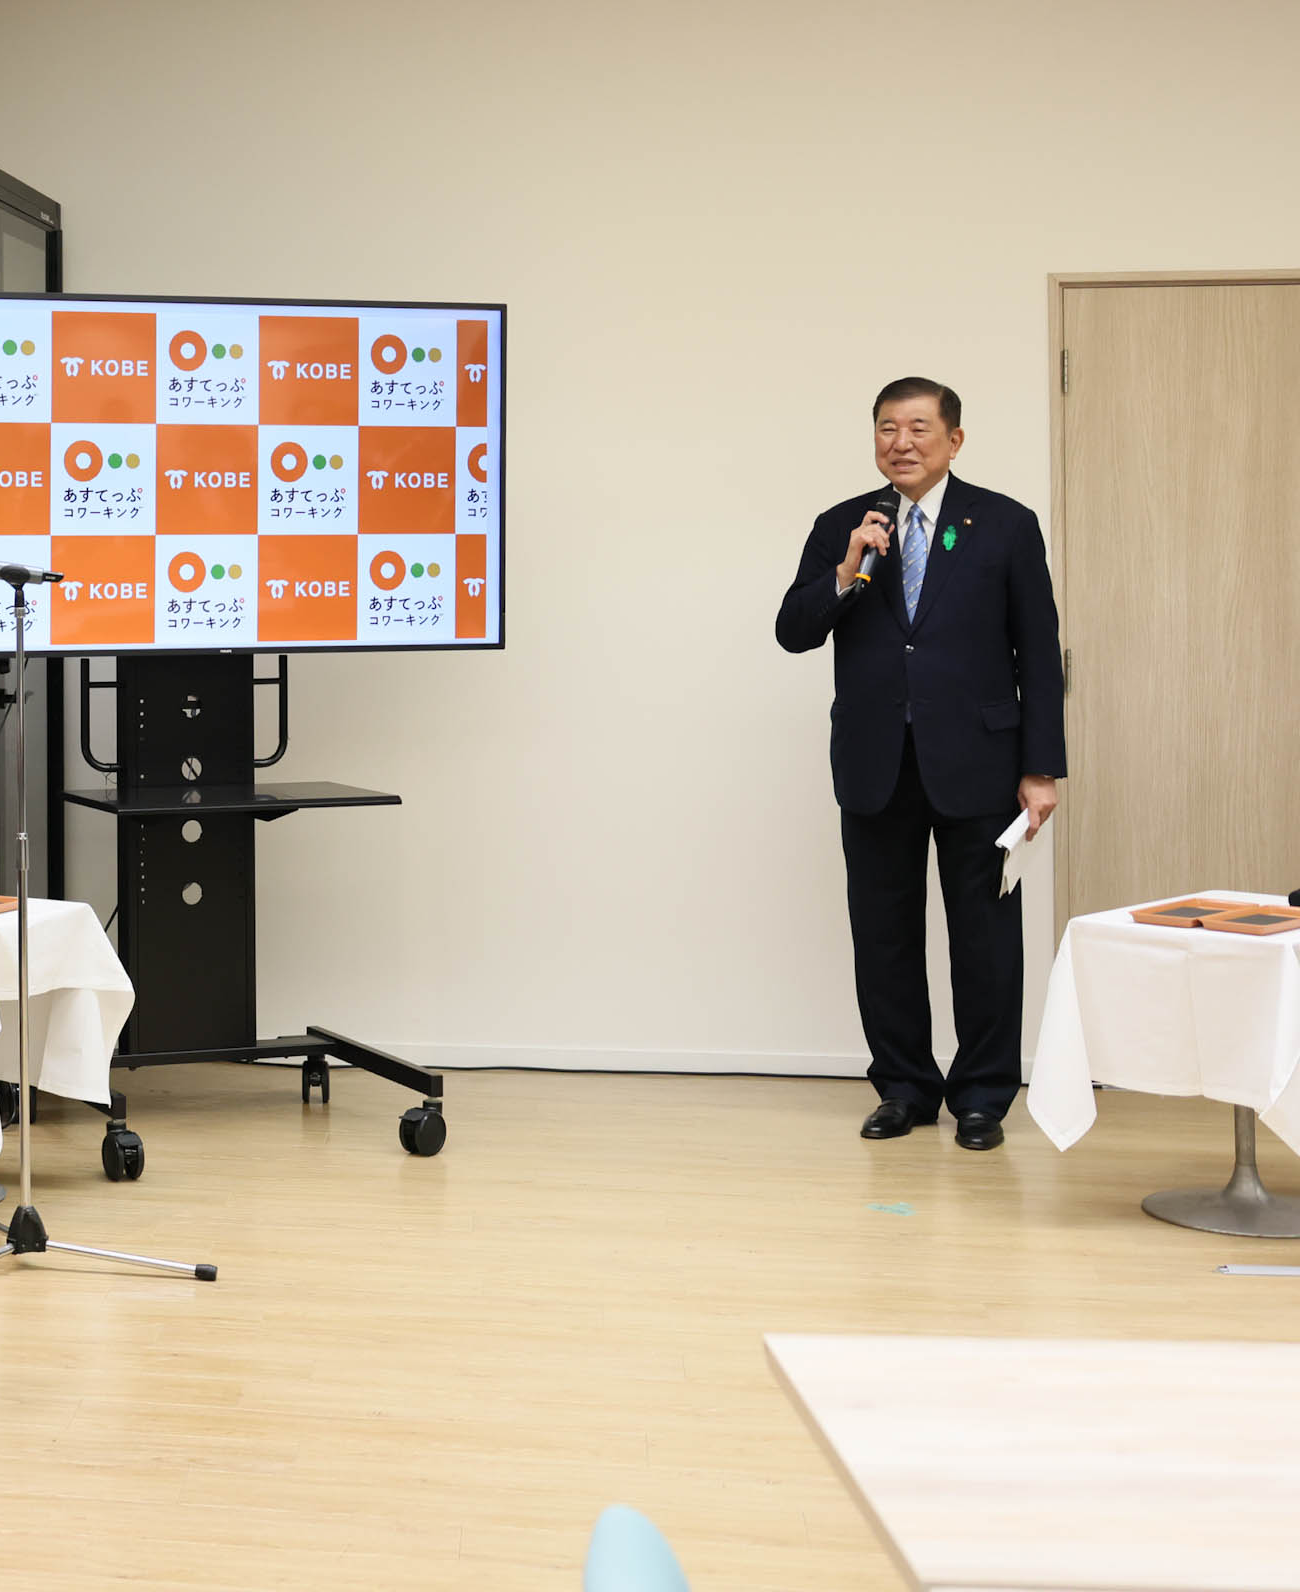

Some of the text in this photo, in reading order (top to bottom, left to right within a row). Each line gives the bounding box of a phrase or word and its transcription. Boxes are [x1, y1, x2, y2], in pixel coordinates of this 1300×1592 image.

[91, 360, 148, 376] KOBE
[297, 363, 351, 379] KOBE
[169, 377, 245, 393] あすてっぷ
[370, 380, 445, 396] あすてっぷ
[169, 397, 244, 409] コワーキング
[371, 400, 442, 411] コワーキング
[194, 472, 250, 488] KOBE
[395, 472, 448, 488] KOBE
[63, 488, 143, 504] あすてっぷ
[270, 488, 346, 503] あすてっぷ
[64, 507, 140, 519] コワーキング
[271, 507, 344, 519] コワーキング
[90, 583, 148, 599] KOBE
[295, 581, 350, 597] KOBE
[168, 597, 245, 613] あすてっぷ
[369, 596, 443, 611] あすてっぷ
[168, 617, 245, 629] コワーキング
[369, 615, 442, 627] コワーキング
